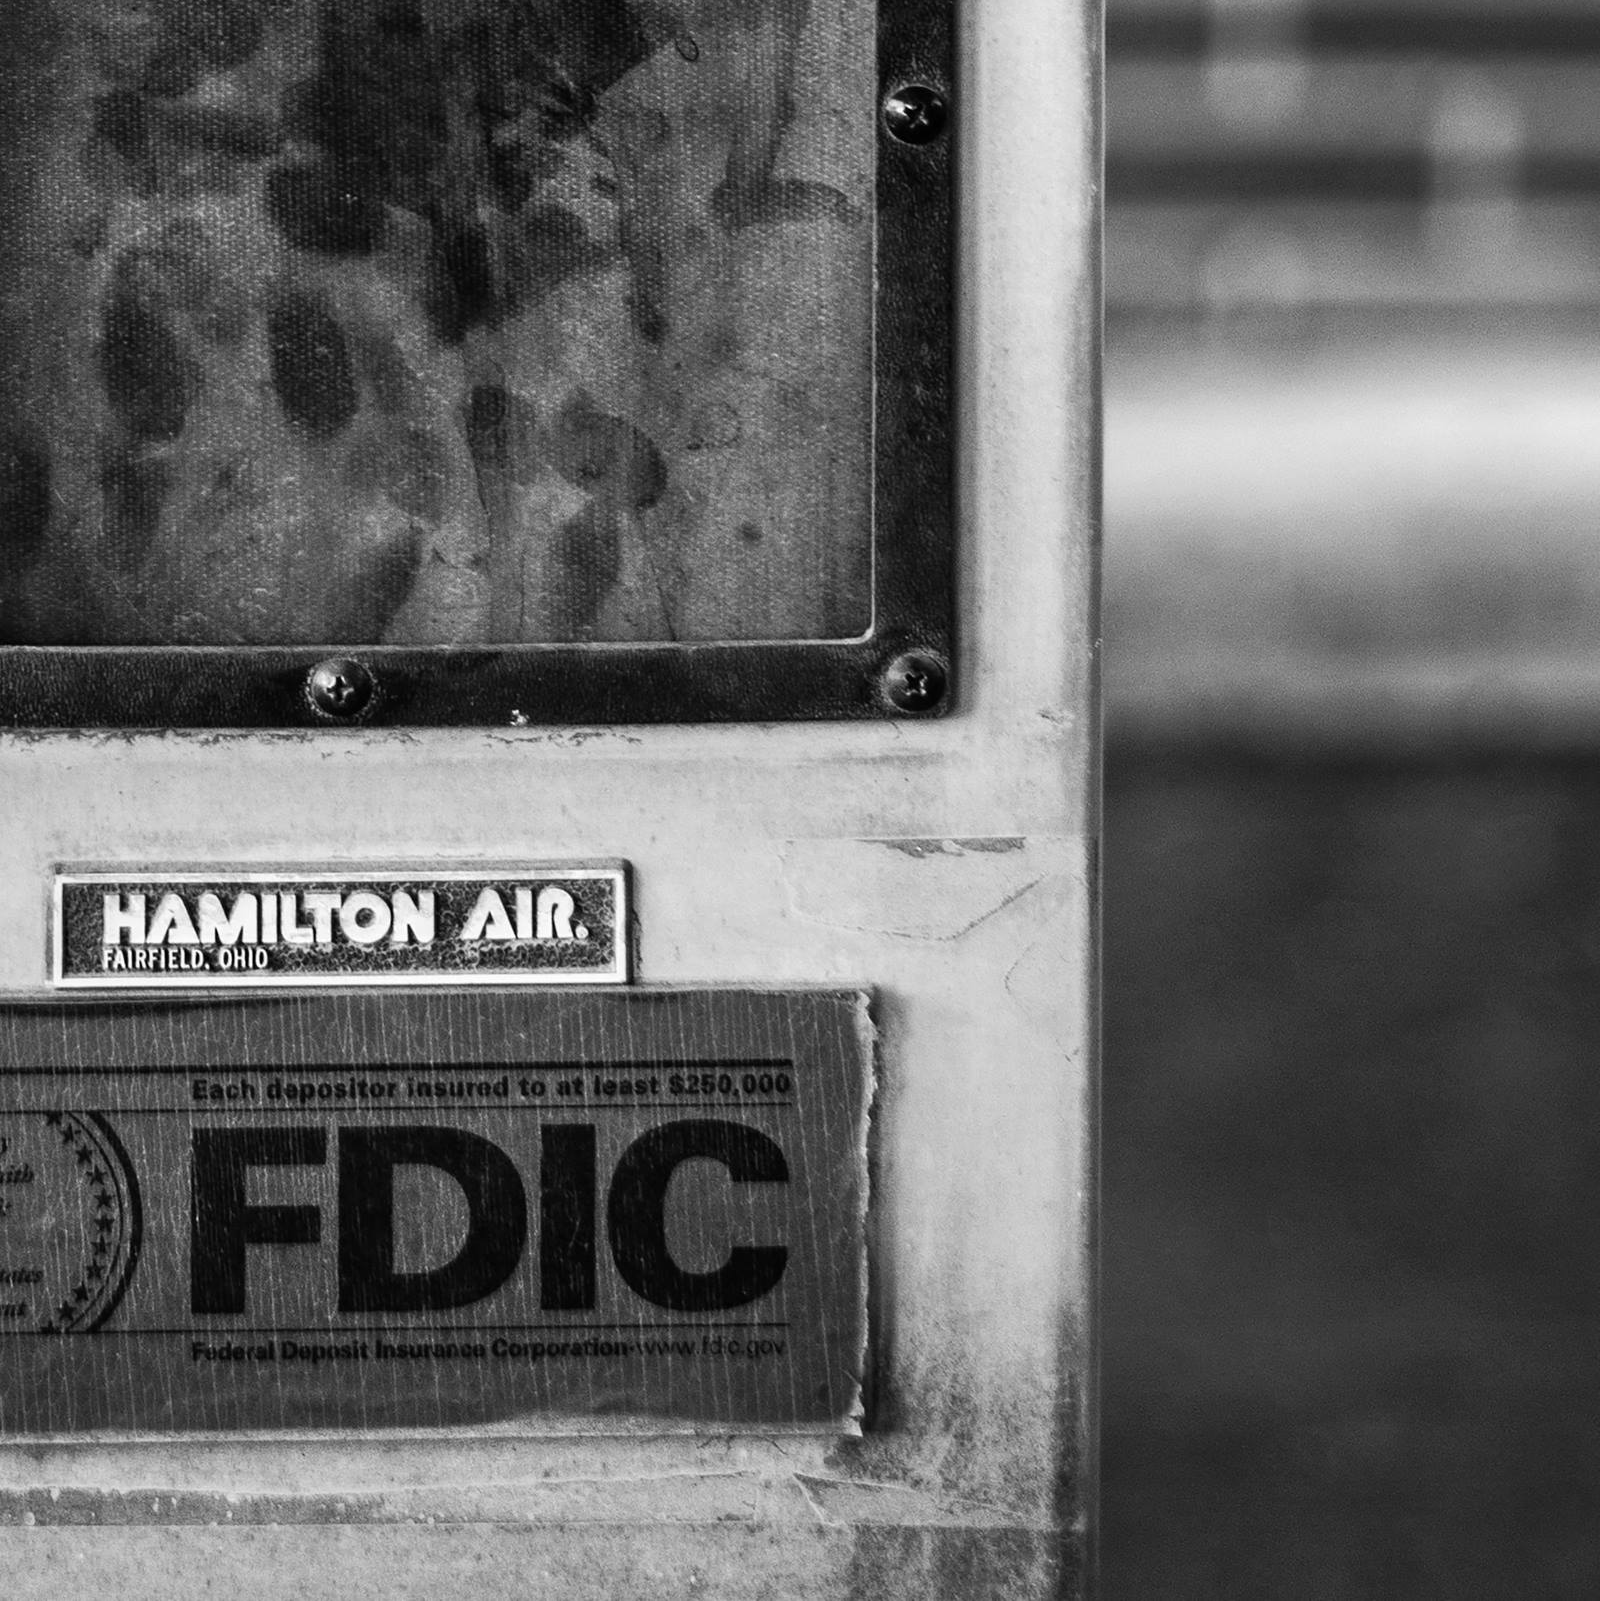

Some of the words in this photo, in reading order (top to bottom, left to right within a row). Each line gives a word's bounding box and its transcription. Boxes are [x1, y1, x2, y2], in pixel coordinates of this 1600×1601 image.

[103, 889, 436, 945] HAMILTON
[219, 947, 269, 969] OHIO
[192, 1079, 256, 1100] Each
[266, 1077, 399, 1103] depositor
[407, 1076, 510, 1098] insured
[518, 1078, 547, 1097] to
[557, 1076, 585, 1096] at
[594, 1074, 659, 1096] least
[669, 1072, 792, 1097] $250,000
[190, 1118, 792, 1316] FDIC
[191, 1341, 275, 1361] Federal
[282, 1340, 368, 1364] Deposit
[374, 1339, 485, 1360] Insurance
[633, 1335, 786, 1358] www.fdc.gov
